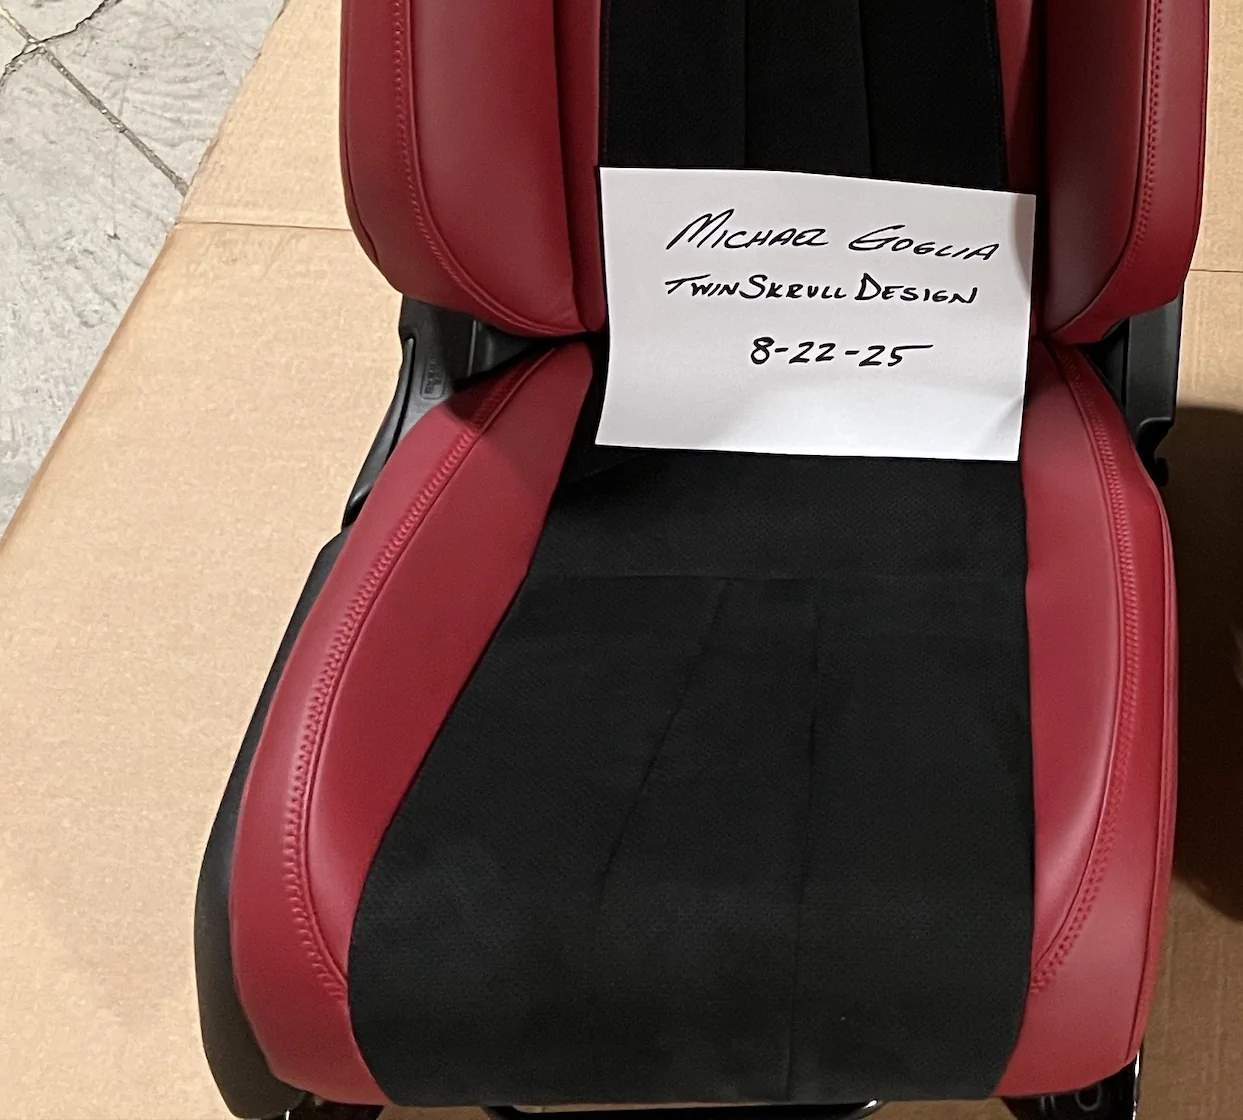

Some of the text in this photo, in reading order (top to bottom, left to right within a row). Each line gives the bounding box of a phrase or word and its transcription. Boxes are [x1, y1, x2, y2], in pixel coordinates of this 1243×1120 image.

[848, 224, 1000, 262] GOGLIA
[854, 272, 979, 305] DESIGN
[750, 336, 935, 368] 8-22-25
